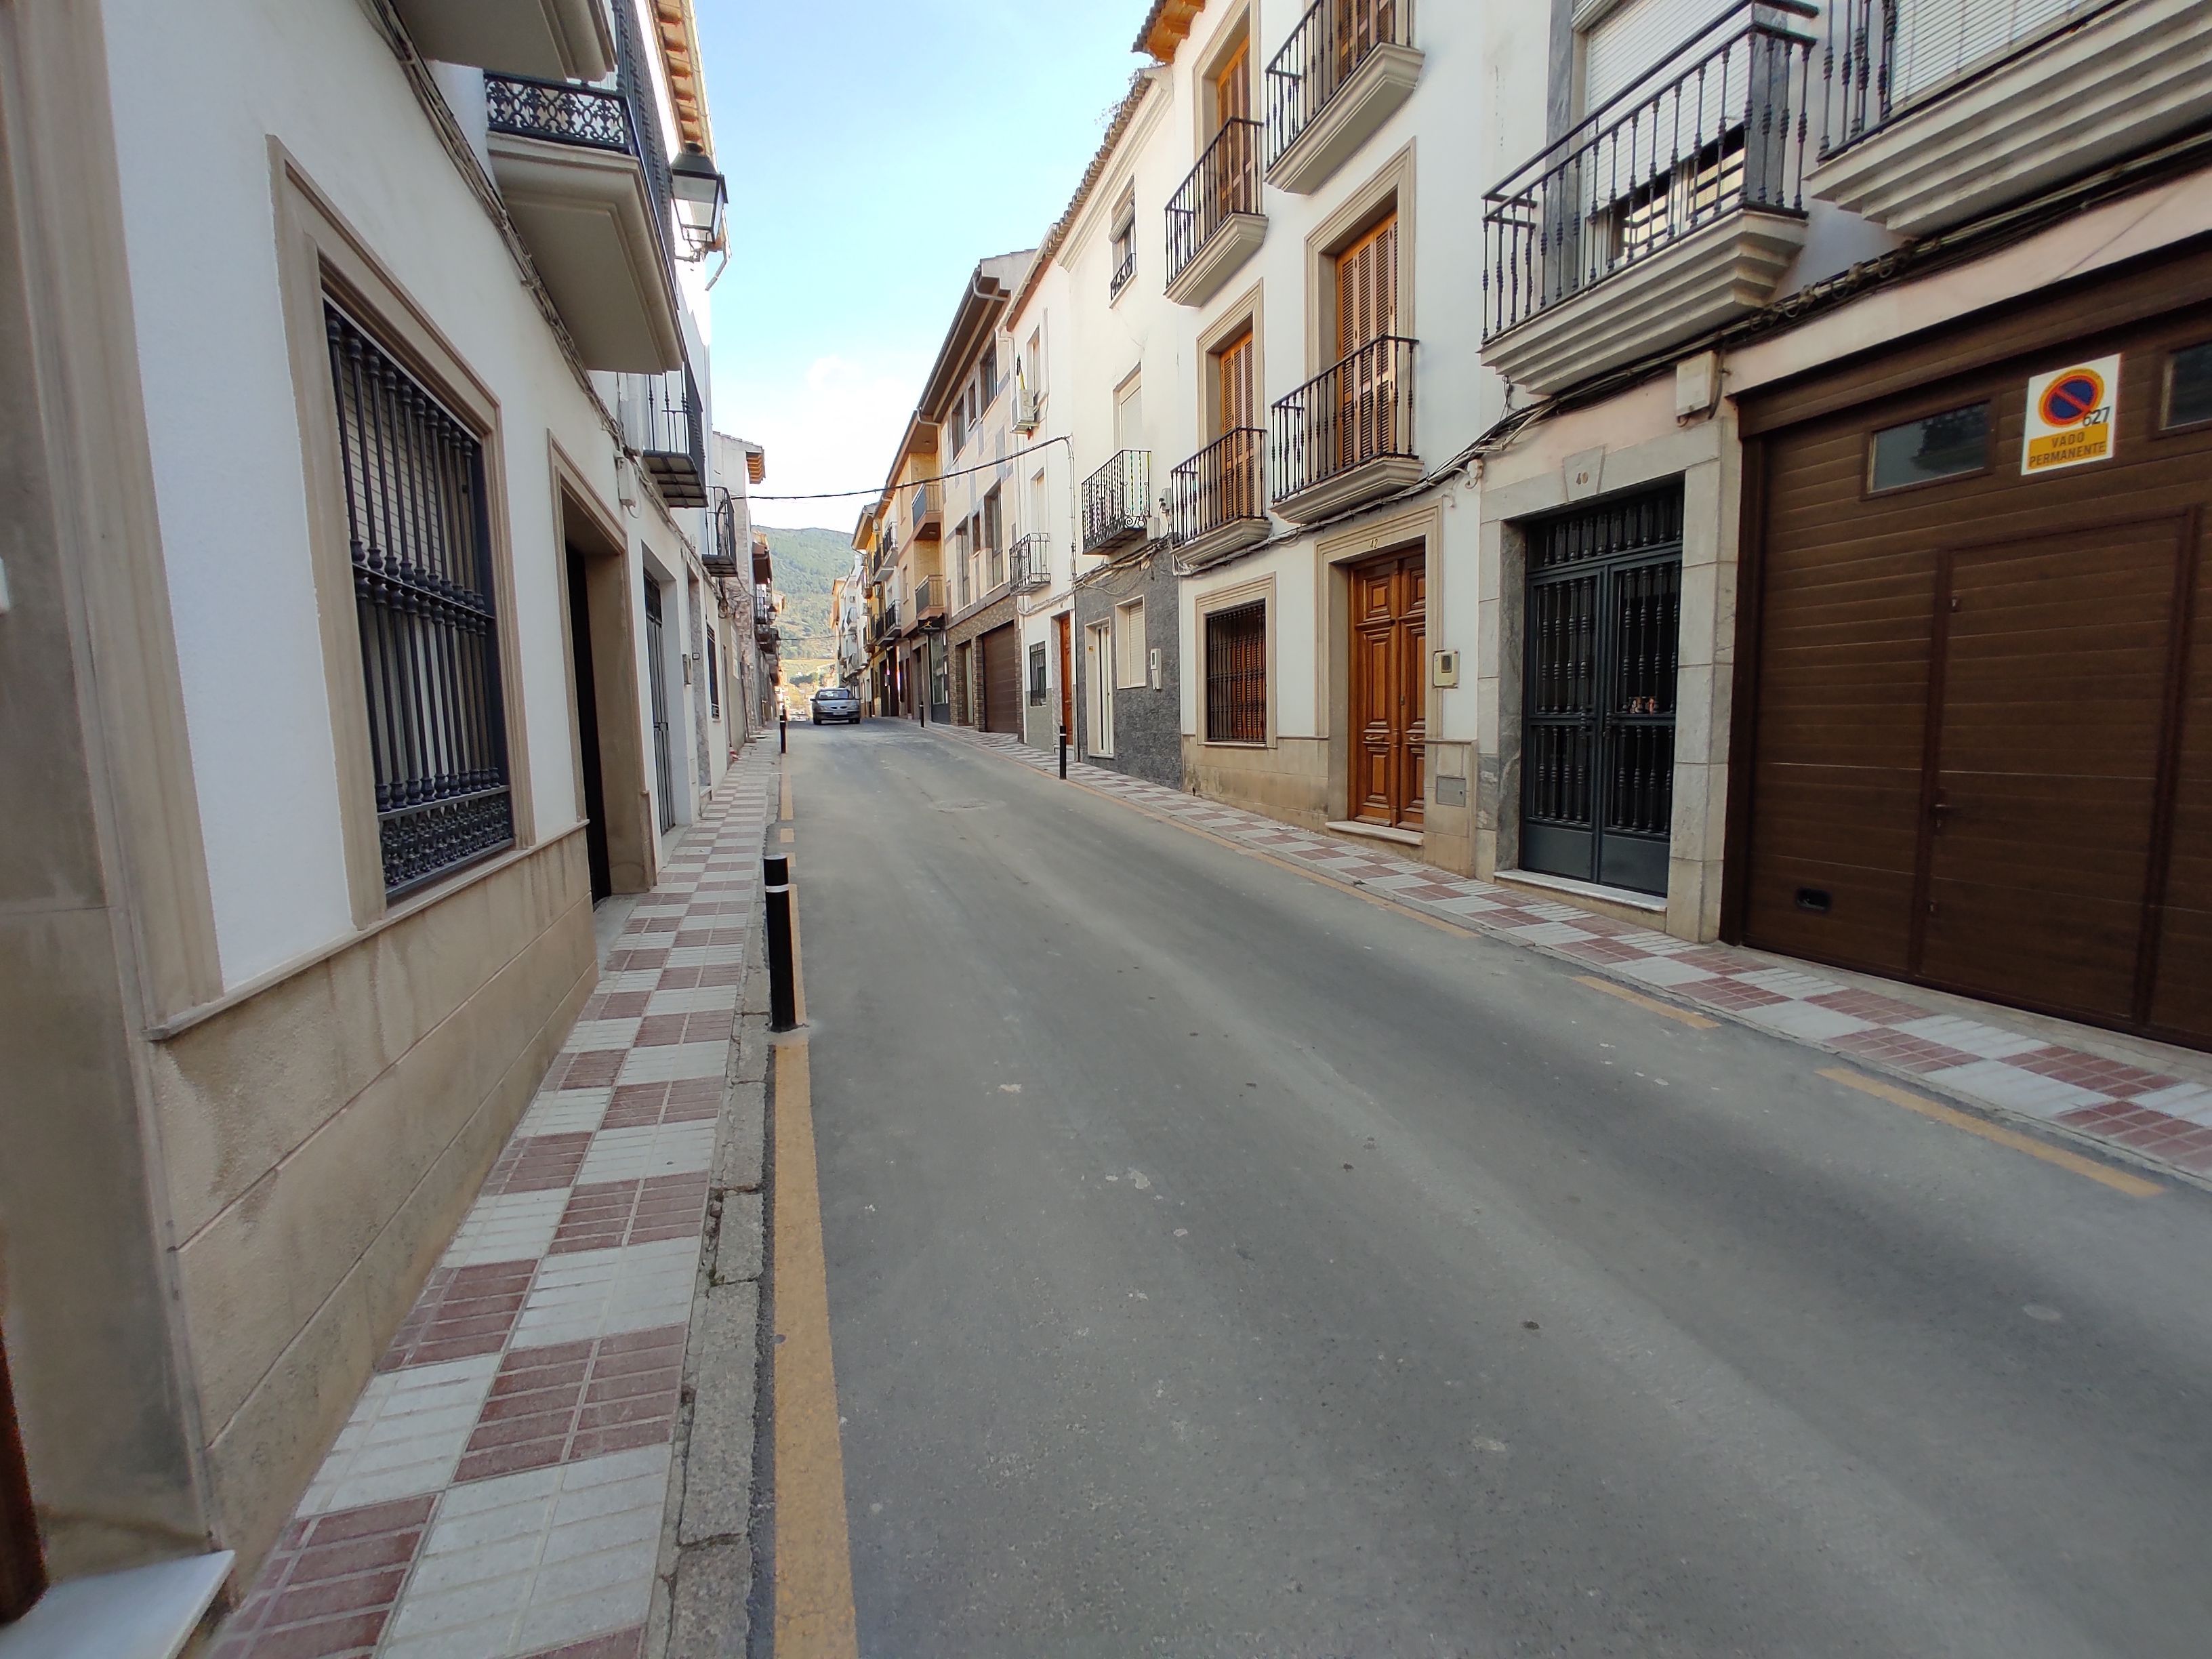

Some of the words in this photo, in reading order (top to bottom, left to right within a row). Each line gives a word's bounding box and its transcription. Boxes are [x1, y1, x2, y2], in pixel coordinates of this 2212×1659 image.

[2083, 407, 2110, 427] 627
[2051, 432, 2085, 448] VADO
[2029, 441, 2106, 464] PERMANENTE
[1370, 539, 1378, 549] 42
